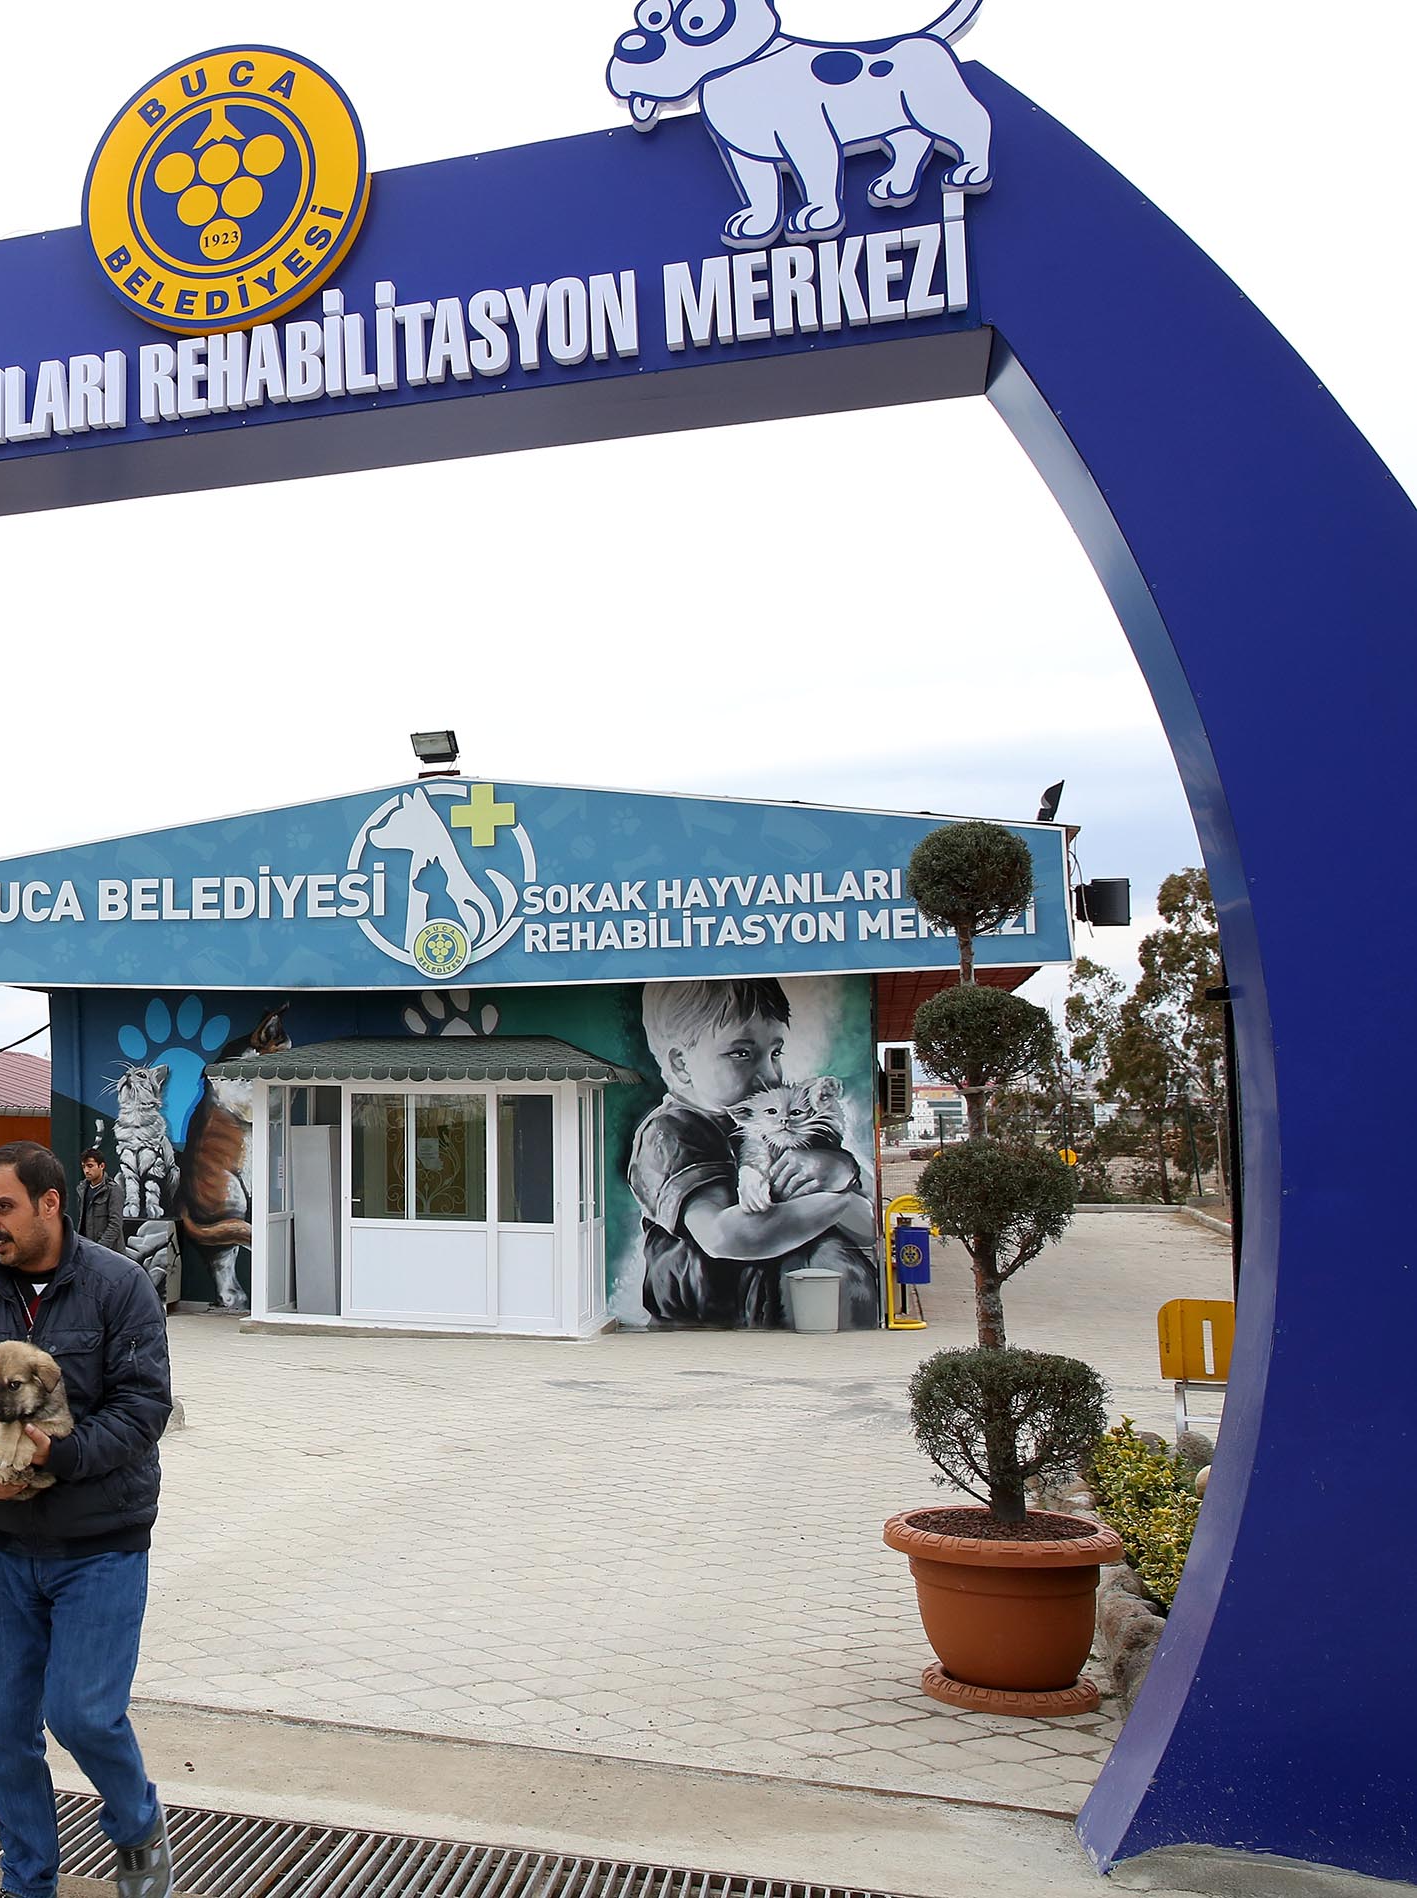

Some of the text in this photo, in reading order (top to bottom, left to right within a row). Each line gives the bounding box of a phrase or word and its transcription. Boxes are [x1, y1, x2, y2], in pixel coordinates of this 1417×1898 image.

[137, 60, 296, 128] BUCA
[104, 204, 344, 316] BELEDİYESİ
[203, 231, 240, 249] 1923
[139, 269, 640, 424] REHABİLİTASYON
[663, 191, 969, 352] MERKEZİ
[97, 861, 386, 922] BELEDİYESİ
[521, 867, 901, 916] SOKAK HAYVANLARI
[424, 925, 456, 936] BUCA
[524, 908, 845, 954] REHABİLİTASYON
